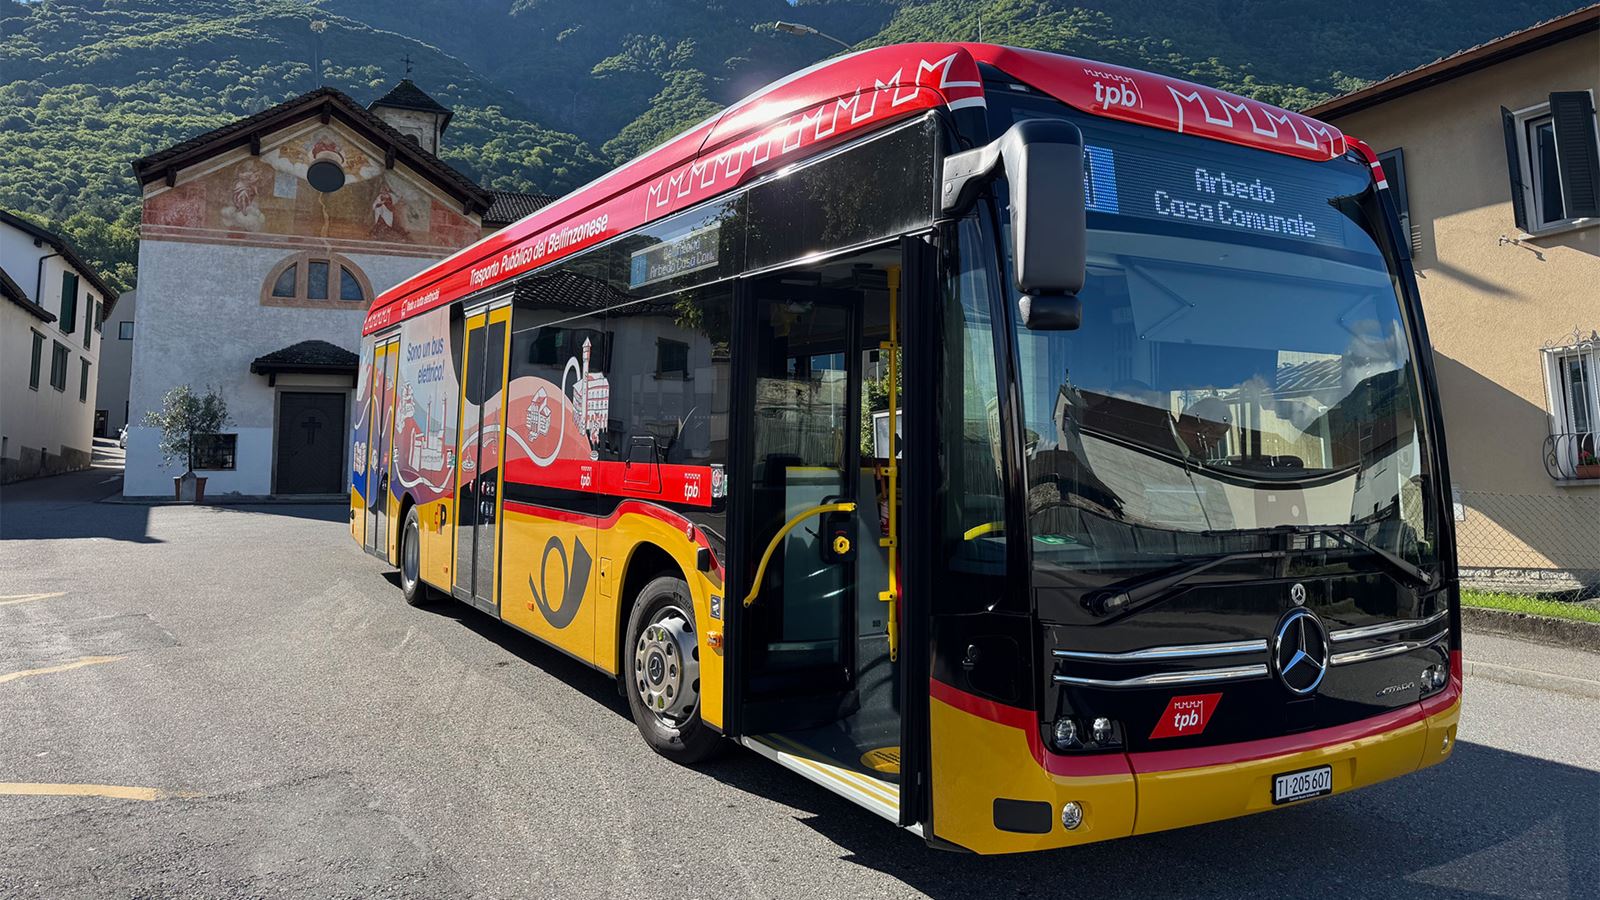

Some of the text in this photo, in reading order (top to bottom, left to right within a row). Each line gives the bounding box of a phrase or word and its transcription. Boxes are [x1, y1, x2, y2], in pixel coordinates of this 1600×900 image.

[1093, 81, 1136, 110] tpb
[1195, 168, 1276, 204] Arbedo
[1154, 190, 1317, 239] Casa Comunale
[470, 213, 608, 287] Trasporto Pubblico del Bellinzonese
[407, 336, 445, 362] Sono un bus
[417, 359, 446, 385] elettrico!
[580, 473, 591, 488] tpb
[684, 481, 699, 501] tpb
[1174, 709, 1199, 731] tpb
